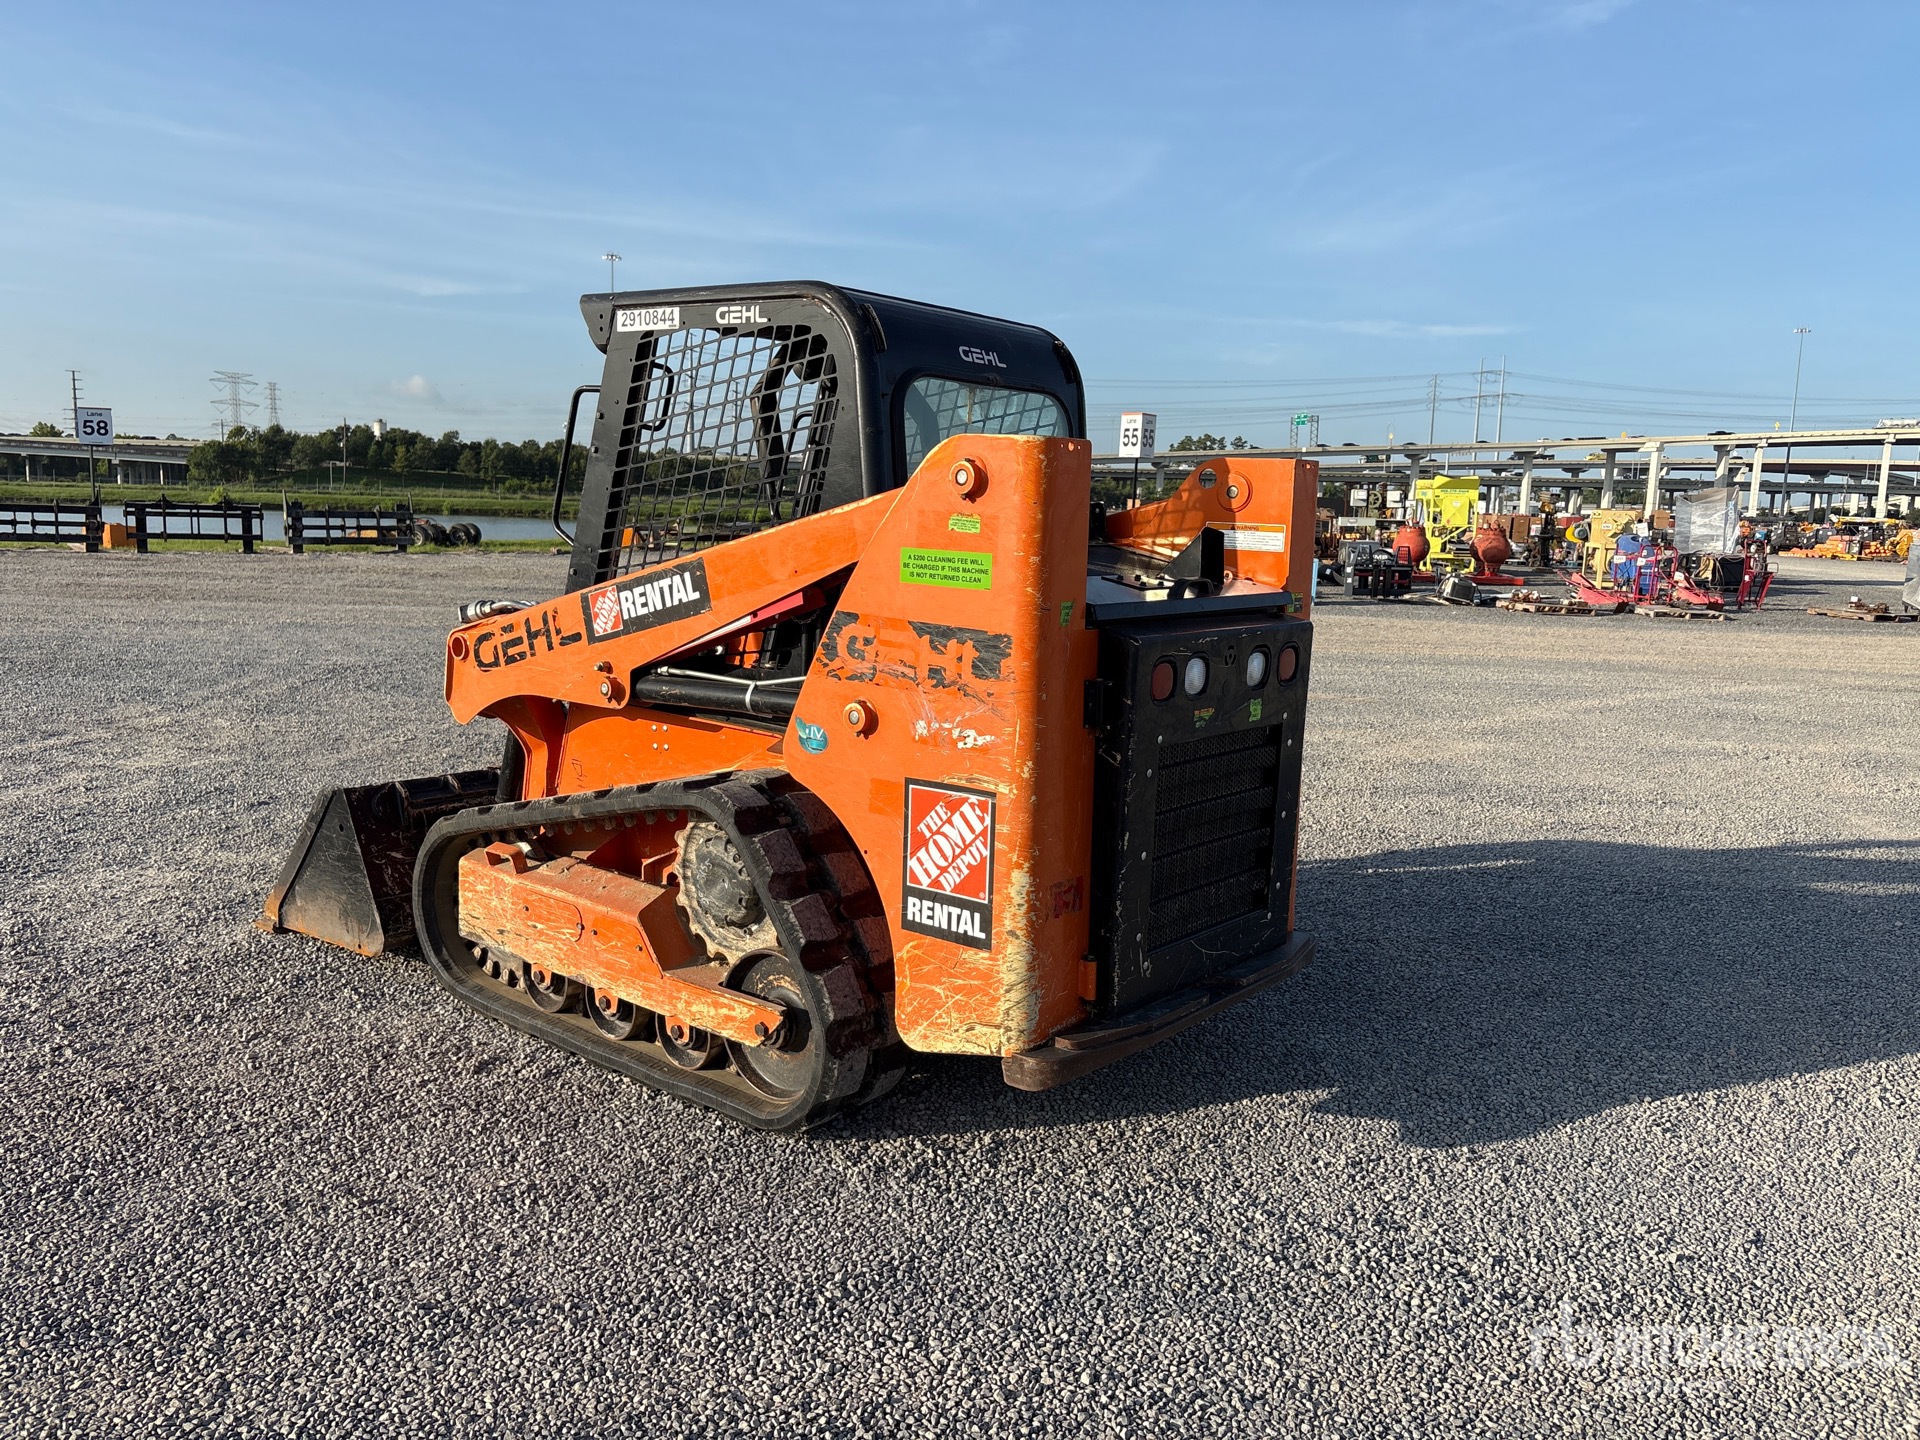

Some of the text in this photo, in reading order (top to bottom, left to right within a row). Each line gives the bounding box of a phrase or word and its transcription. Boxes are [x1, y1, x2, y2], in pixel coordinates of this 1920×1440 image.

[621, 309, 675, 327] 2910844
[715, 305, 768, 324] GEHL
[958, 345, 1007, 368] GEHL
[82, 419, 109, 436] 58
[1122, 427, 1139, 447] 55
[1142, 428, 1155, 448] 55
[926, 555, 956, 563] CLEANING
[928, 573, 960, 581] RETURNED
[961, 567, 989, 575] MACHINE
[619, 571, 700, 620] RENTAL
[594, 587, 617, 635] HOME
[474, 607, 583, 672] GEHL
[916, 801, 951, 839] THE
[908, 797, 990, 888] HOME
[936, 836, 989, 893] DEPOT
[907, 896, 986, 940] RENTAL
